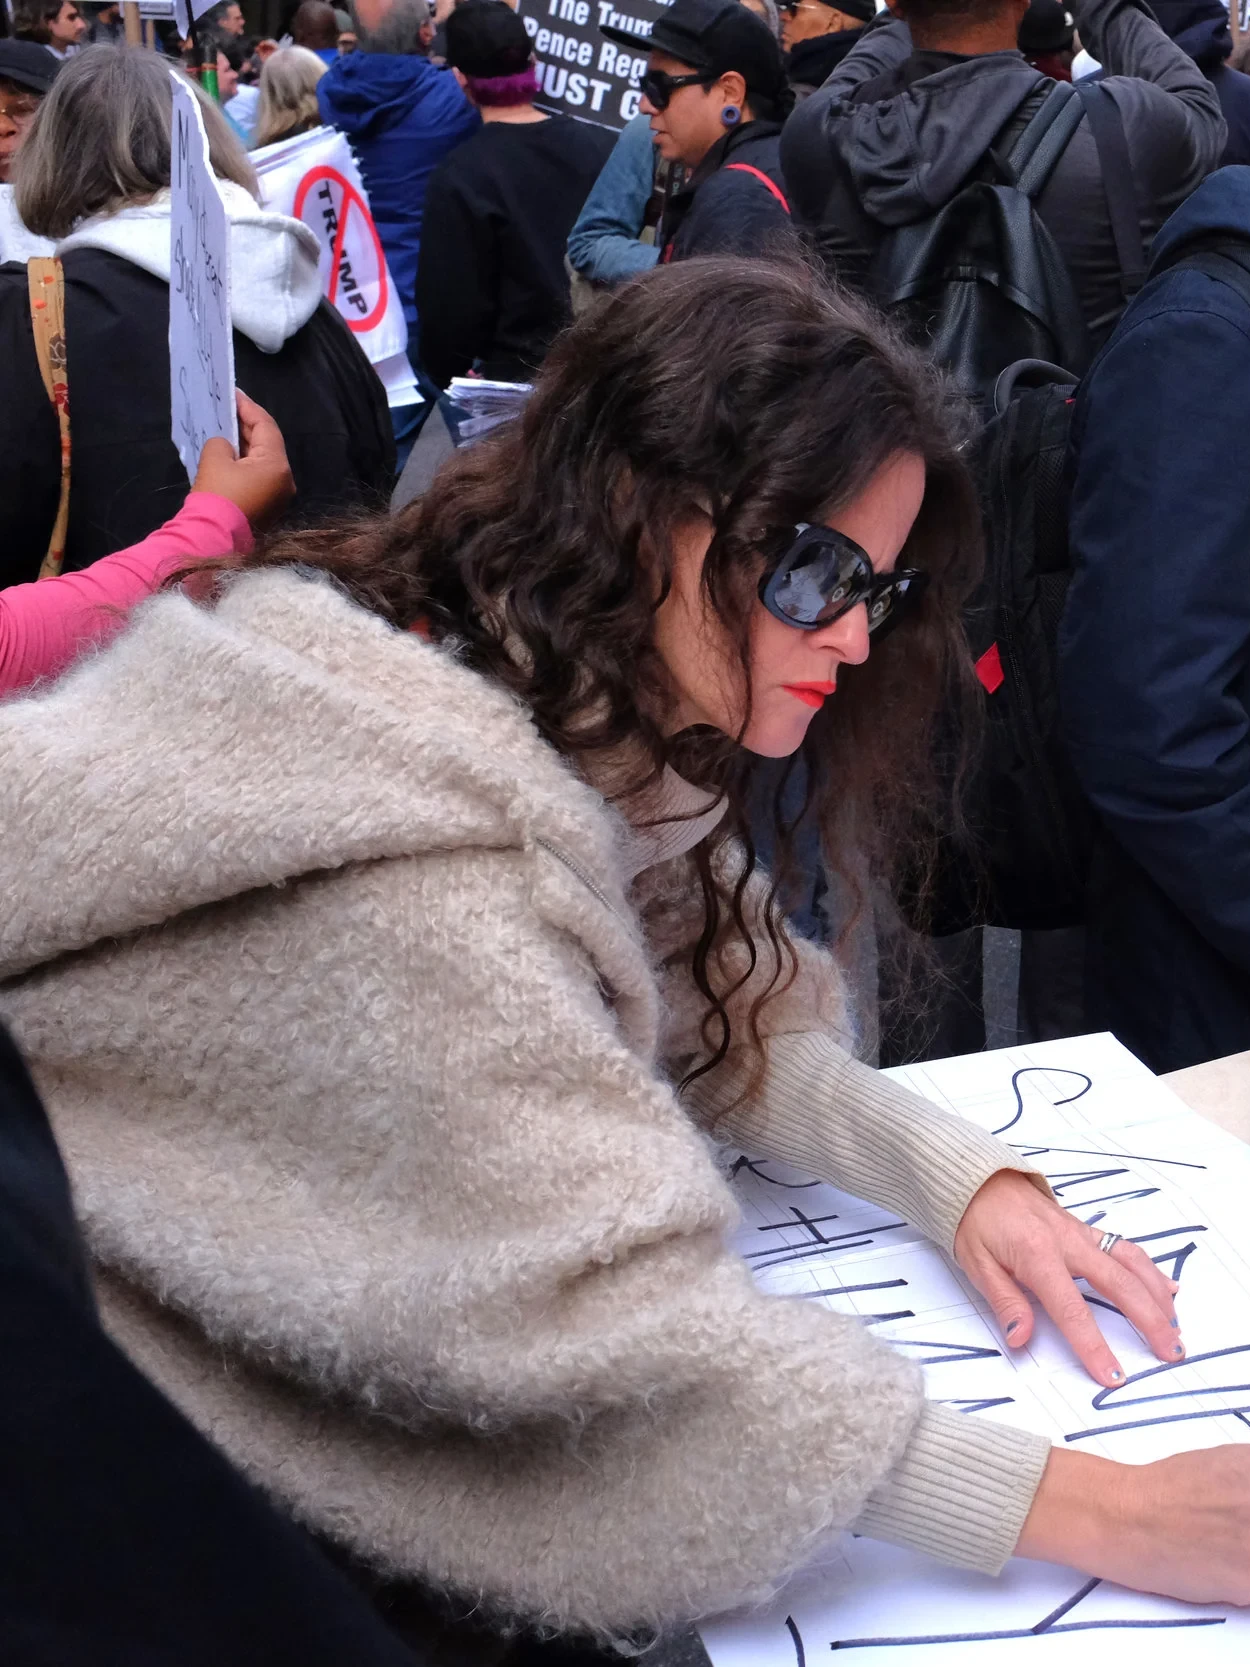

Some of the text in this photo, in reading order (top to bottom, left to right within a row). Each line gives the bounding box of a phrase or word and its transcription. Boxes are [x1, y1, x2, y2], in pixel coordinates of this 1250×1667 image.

[598, 2, 654, 36] Trum
[523, 16, 648, 88] Pence Reg
[619, 89, 643, 121] G
